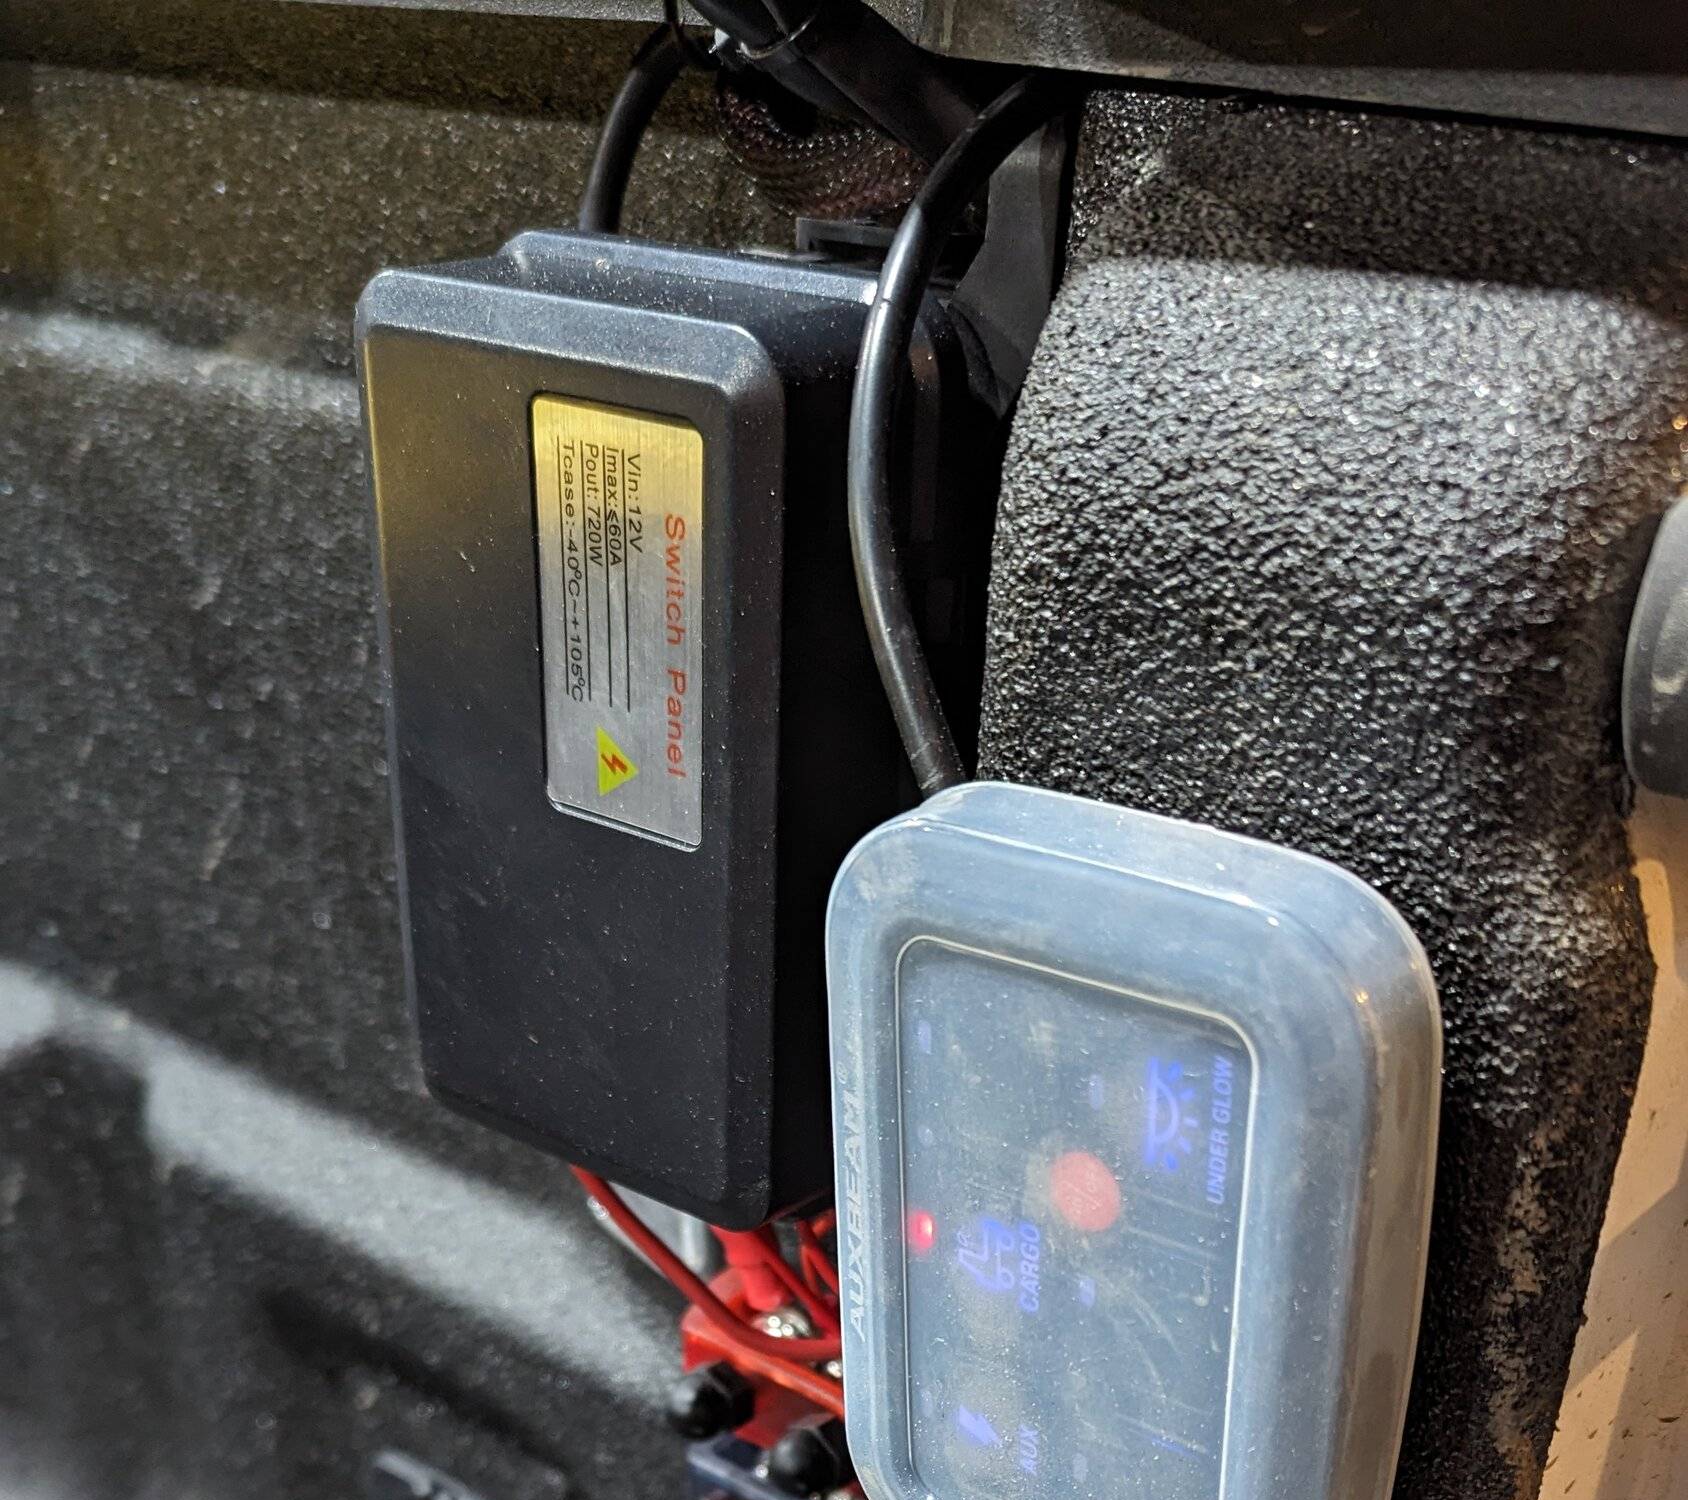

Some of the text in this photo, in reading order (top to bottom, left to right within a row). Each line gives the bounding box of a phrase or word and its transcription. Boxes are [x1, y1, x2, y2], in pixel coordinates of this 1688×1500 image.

[626, 452, 644, 554] Vin:12V
[665, 513, 687, 779] Switch Panel
[1207, 1055, 1233, 1204] UNDER GLOW
[1018, 1222, 1041, 1313] CARGO
[1019, 1426, 1040, 1477] AUX
